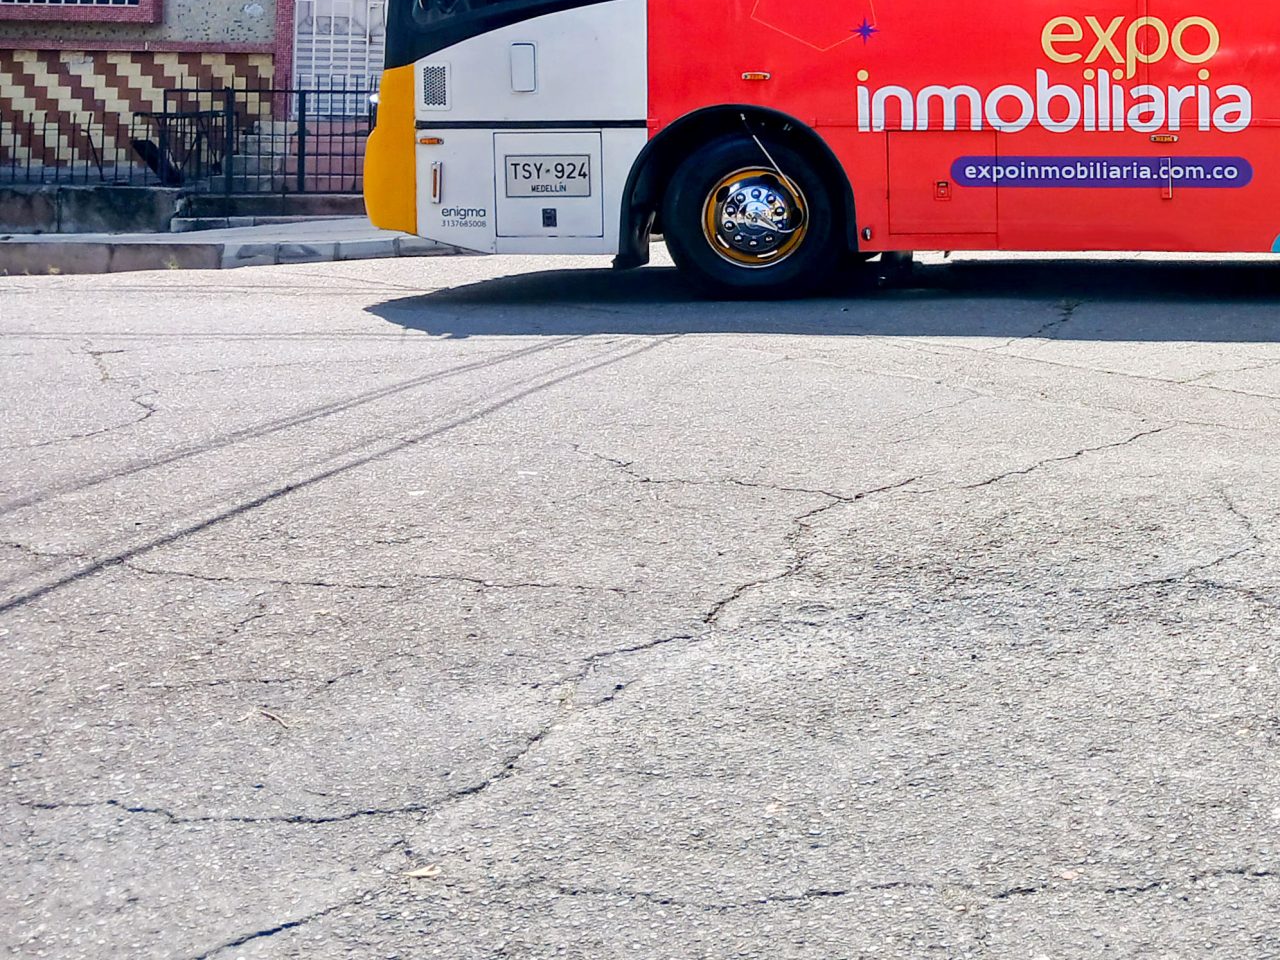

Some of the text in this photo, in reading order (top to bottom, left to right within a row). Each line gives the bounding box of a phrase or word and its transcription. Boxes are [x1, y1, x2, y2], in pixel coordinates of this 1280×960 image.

[1041, 16, 1220, 79] expo
[857, 68, 1252, 133] inmobiliaria
[964, 161, 1239, 185] expoinmobiliaria.com.co
[531, 181, 567, 192] MEDELLÍN
[441, 205, 486, 220] enigma
